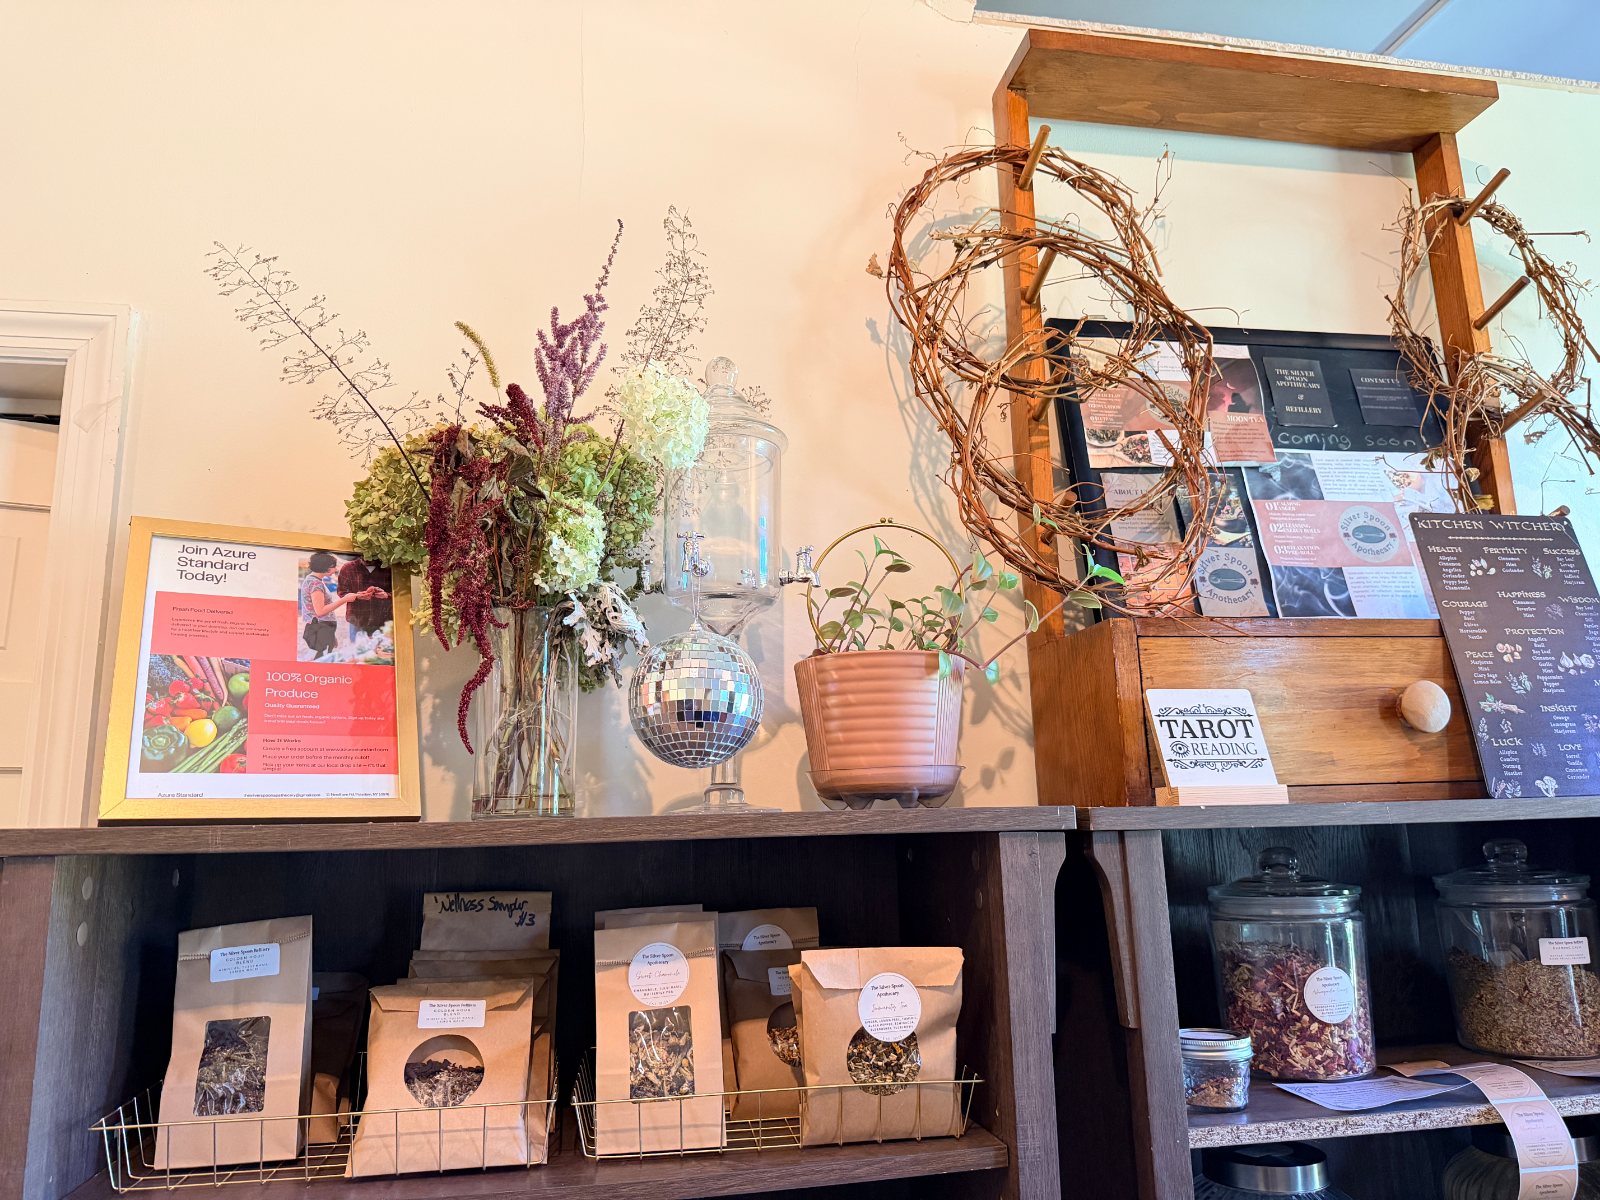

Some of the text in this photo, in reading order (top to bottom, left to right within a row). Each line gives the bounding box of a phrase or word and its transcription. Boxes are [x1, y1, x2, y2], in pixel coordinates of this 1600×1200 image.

[1276, 381, 1321, 389] APOTHECARY
[1286, 406, 1322, 414] REFILLERY
[1278, 432, 1352, 450] Coming
[1340, 512, 1360, 530] Silver
[1364, 512, 1391, 532] Spoon
[1418, 520, 1565, 532] KITCHEN WITCHERY
[178, 545, 257, 560] Join Azure
[1352, 541, 1394, 556] Apothecary
[1483, 547, 1528, 555] FERTILITY
[1543, 548, 1581, 556] SUCCESS
[177, 556, 249, 572] Standard
[1198, 553, 1253, 576] Silver Spoon
[176, 569, 227, 584] Today!
[1442, 600, 1488, 608] COURAGE
[1497, 590, 1600, 604] HAPPINESS WISDOM
[1504, 627, 1565, 635] PROTECTION
[1464, 651, 1495, 659] PEACE
[266, 672, 352, 686] 100% Organic
[265, 688, 318, 699] Produce
[1539, 704, 1577, 712] INSIGHT
[1159, 719, 1254, 739] TAROT
[1490, 737, 1523, 746] LUCK
[1190, 742, 1258, 756] READING
